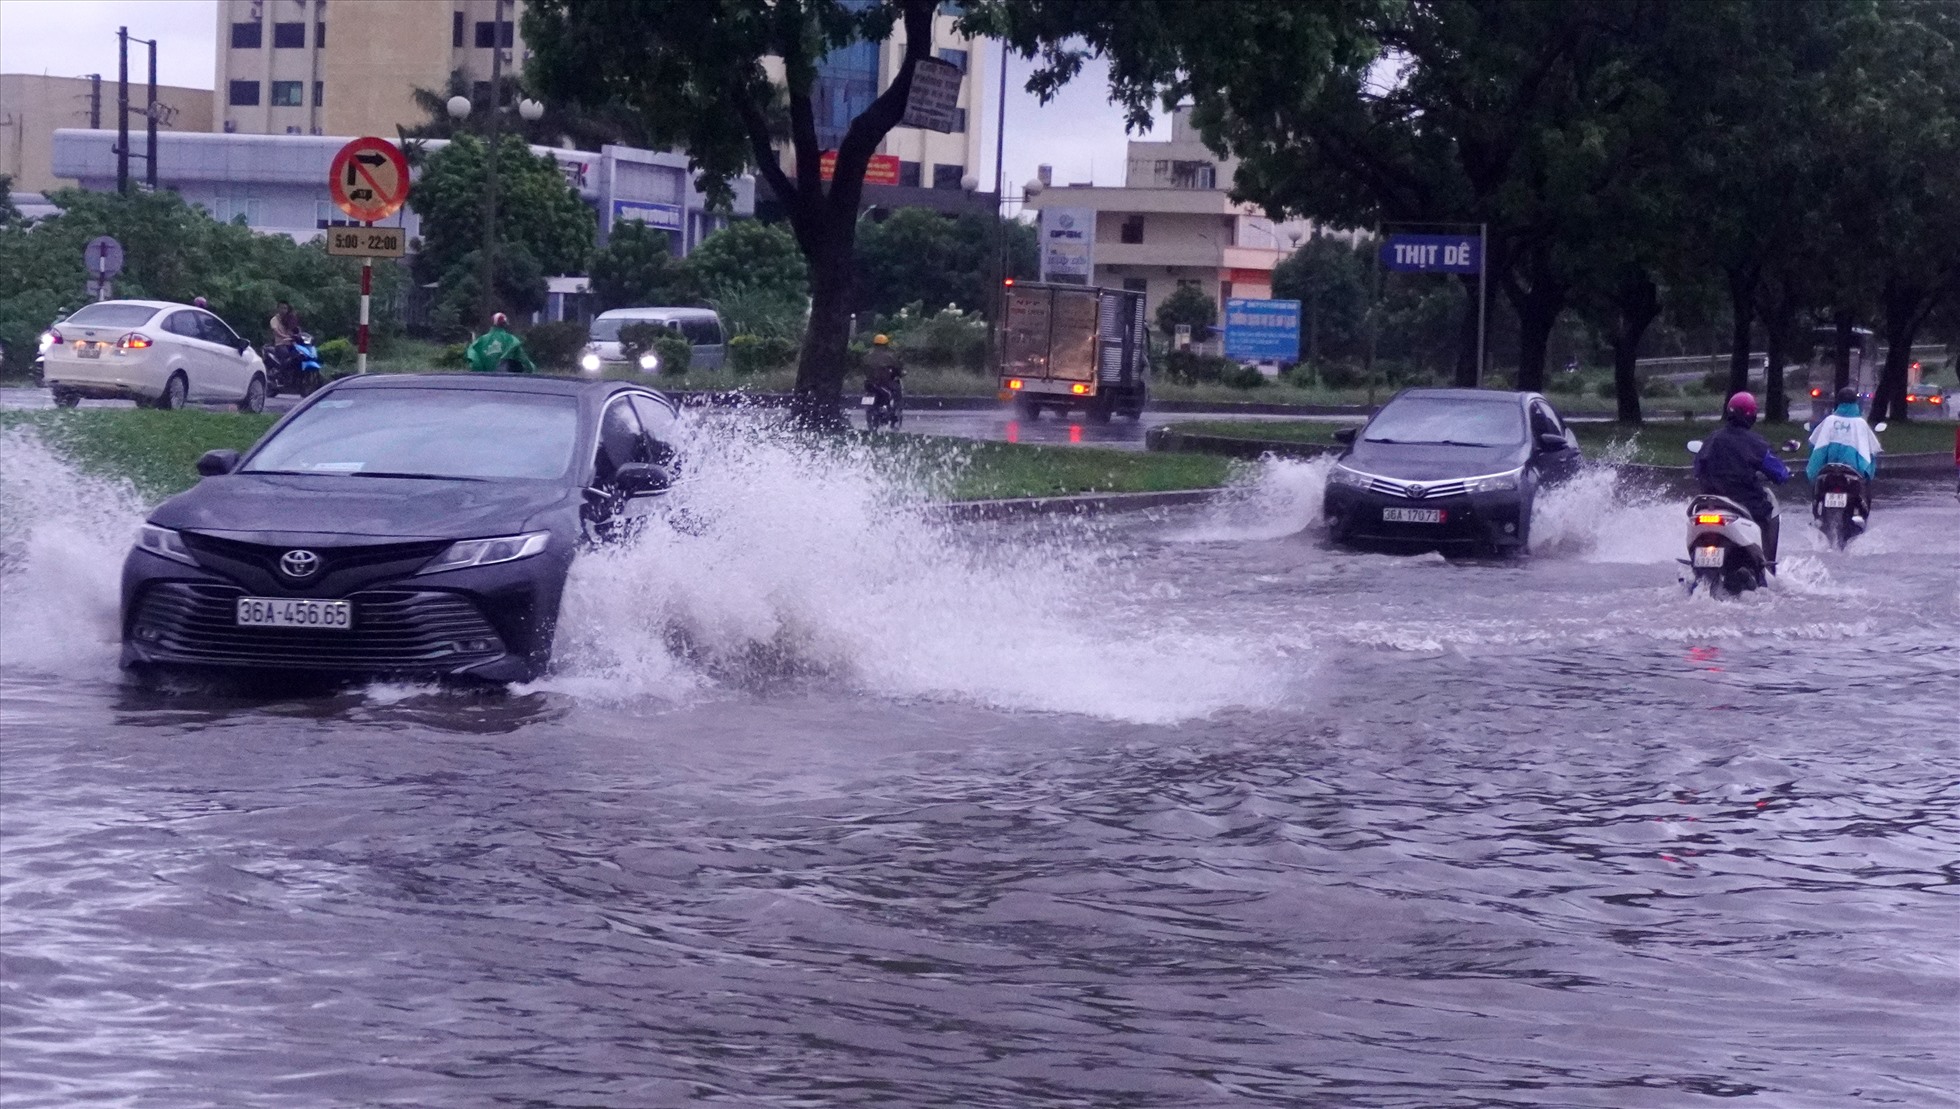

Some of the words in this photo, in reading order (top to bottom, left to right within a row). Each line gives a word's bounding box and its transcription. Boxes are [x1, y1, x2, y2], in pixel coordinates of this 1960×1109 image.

[335, 234, 358, 249] 5:00
[368, 236, 397, 250] 22:00
[1394, 243, 1438, 268] THỊT
[1443, 241, 1470, 266] DÊ
[240, 601, 347, 626] 36A-456.65
